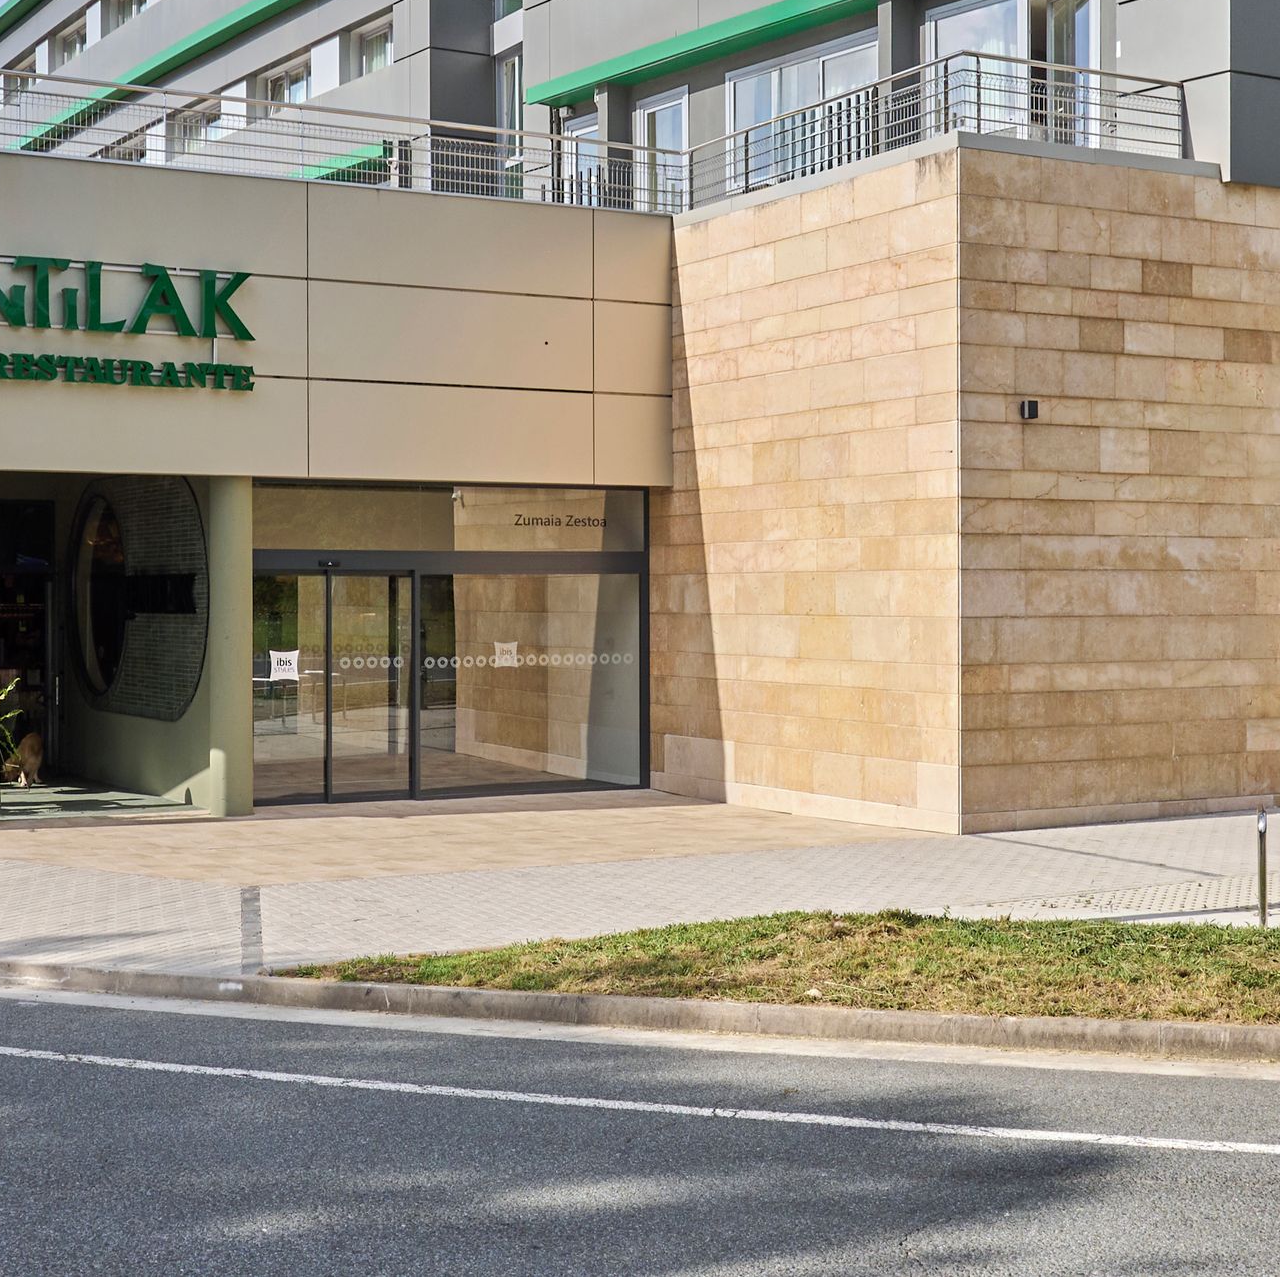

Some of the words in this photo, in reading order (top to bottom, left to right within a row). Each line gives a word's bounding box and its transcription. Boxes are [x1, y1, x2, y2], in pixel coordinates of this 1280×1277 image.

[514, 514, 561, 527] Zumaia
[565, 515, 607, 528] Zestoa
[276, 658, 293, 667] ibis
